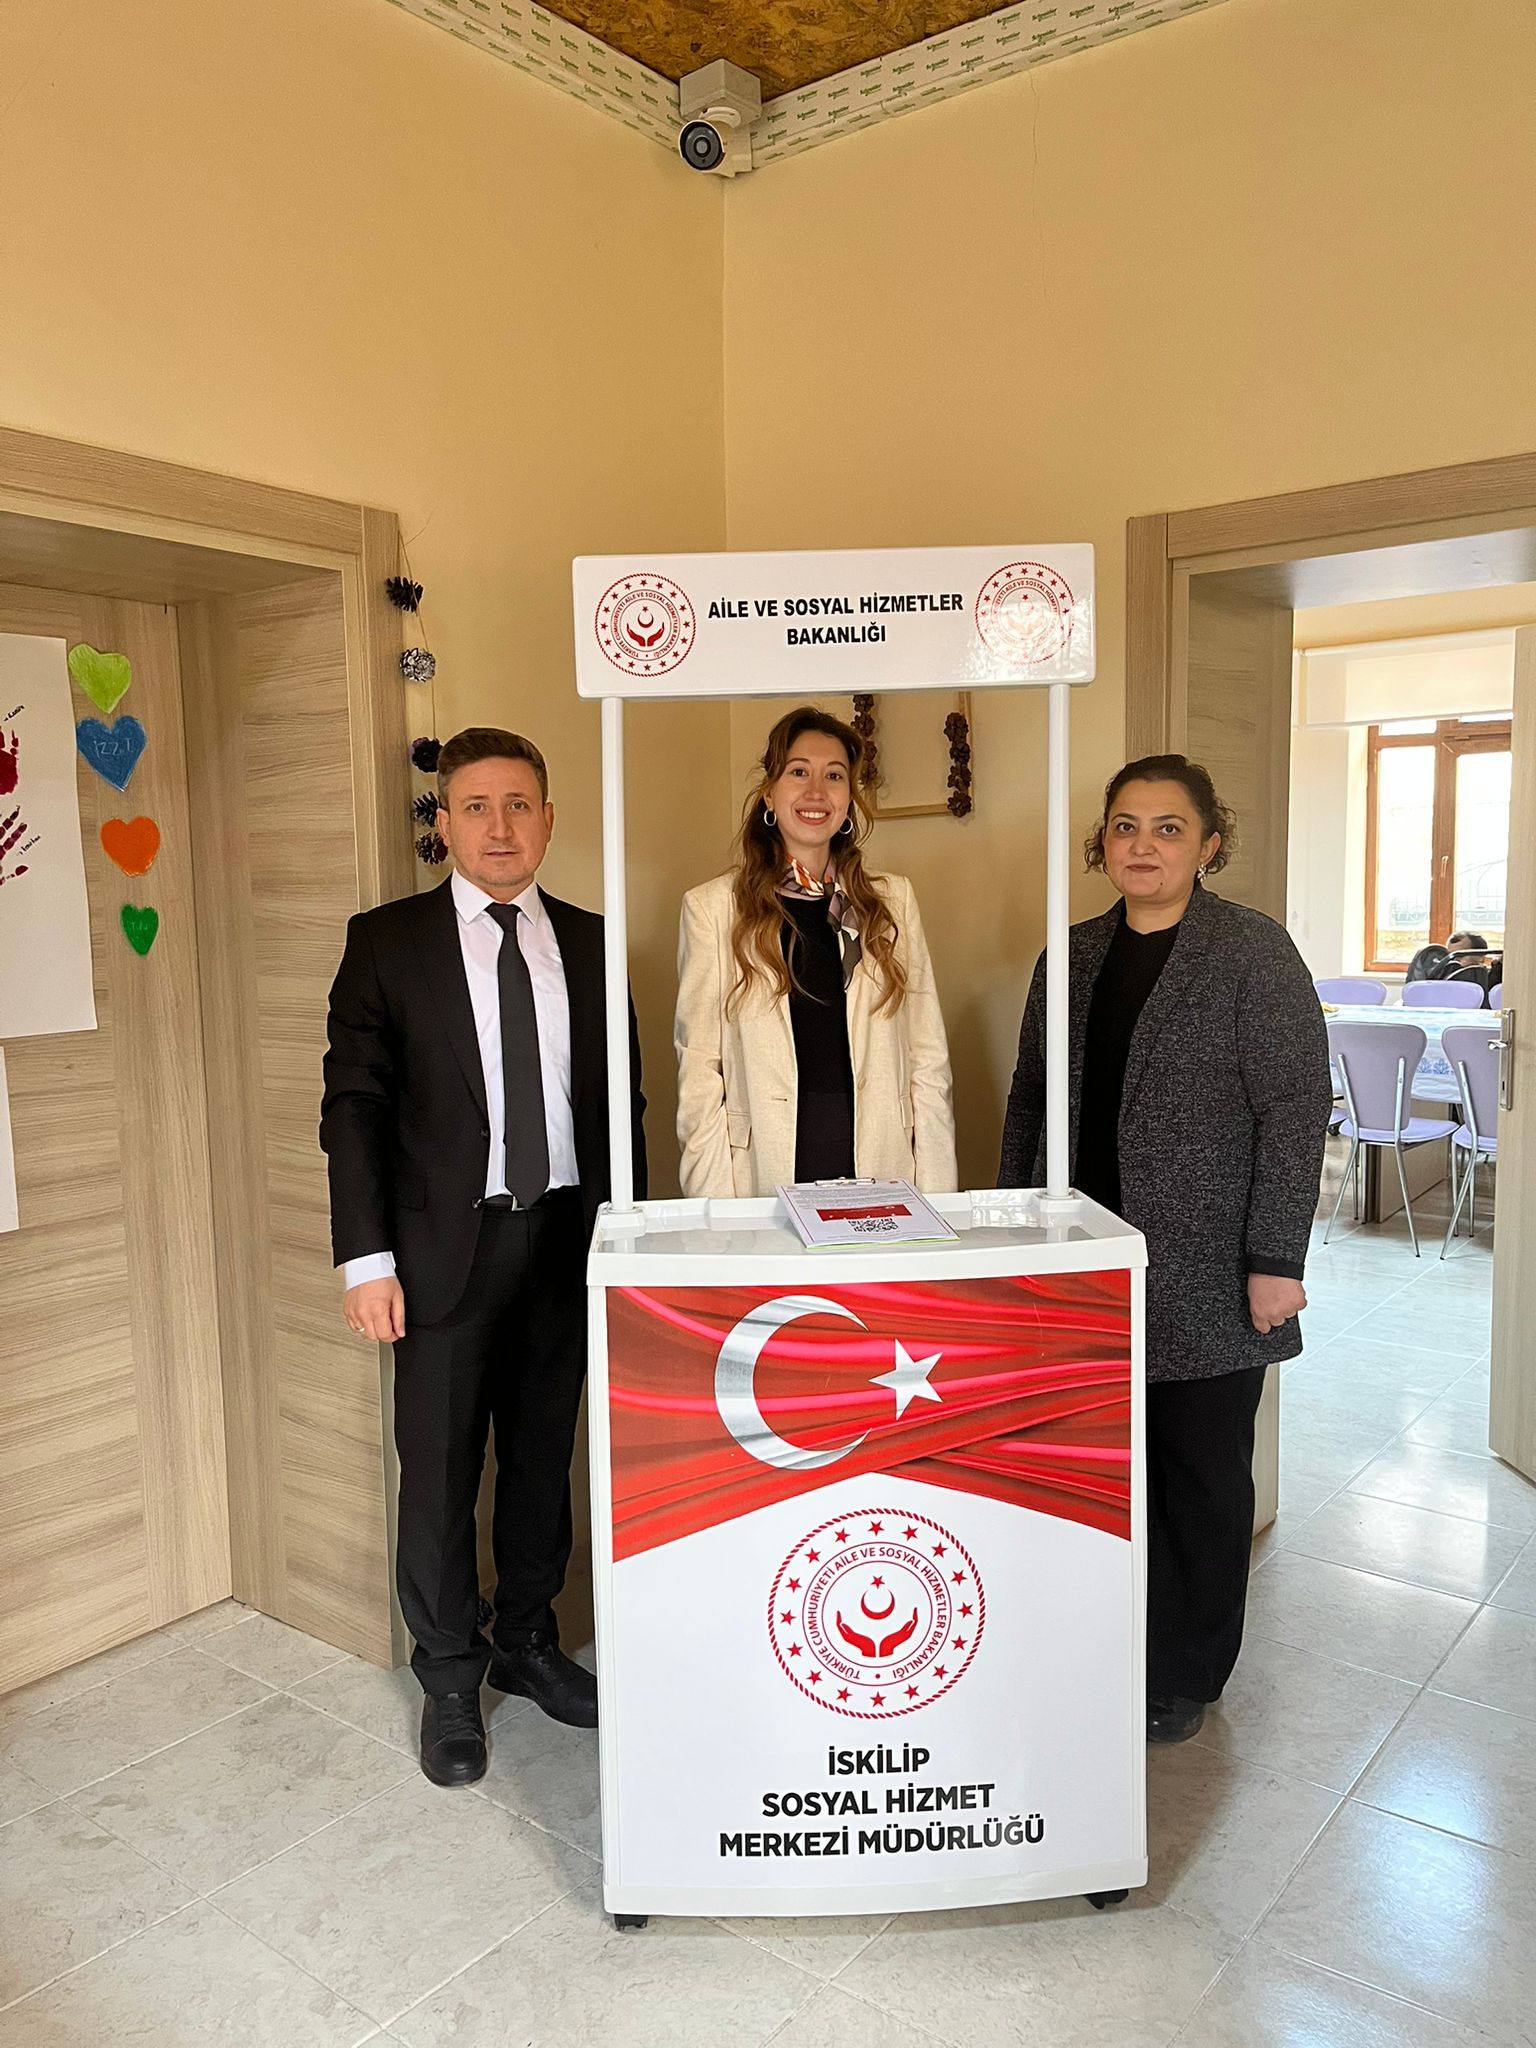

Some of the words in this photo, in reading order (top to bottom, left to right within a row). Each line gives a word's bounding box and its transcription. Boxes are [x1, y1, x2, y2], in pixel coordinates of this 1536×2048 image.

[645, 592, 666, 603] SOSYAL
[1025, 580, 1046, 592] SOSYAL
[708, 597, 749, 618] AİLE
[754, 600, 778, 616] VE
[784, 597, 854, 616] SOSYAL
[860, 592, 963, 614] HİZMETLER
[787, 621, 886, 645] BAKANLIĞI
[834, 1551, 859, 1571] AİLE
[860, 1547, 876, 1558] VE
[879, 1547, 920, 1569] SOSYAL
[808, 1567, 835, 1645] CUMHURİYETİ
[921, 1566, 947, 1629] HİZMETLER
[819, 1648, 860, 1679] TÜRKİYE
[893, 1631, 943, 1678] BAKANLIĞI
[829, 1742, 930, 1776] İSKİLİP
[762, 1790, 877, 1817] SOSYAL
[886, 1782, 995, 1814] HİZMET
[720, 1825, 849, 1857] MERKEZİ
[858, 1814, 1045, 1855] MÜDÜRLÜĞÜ
